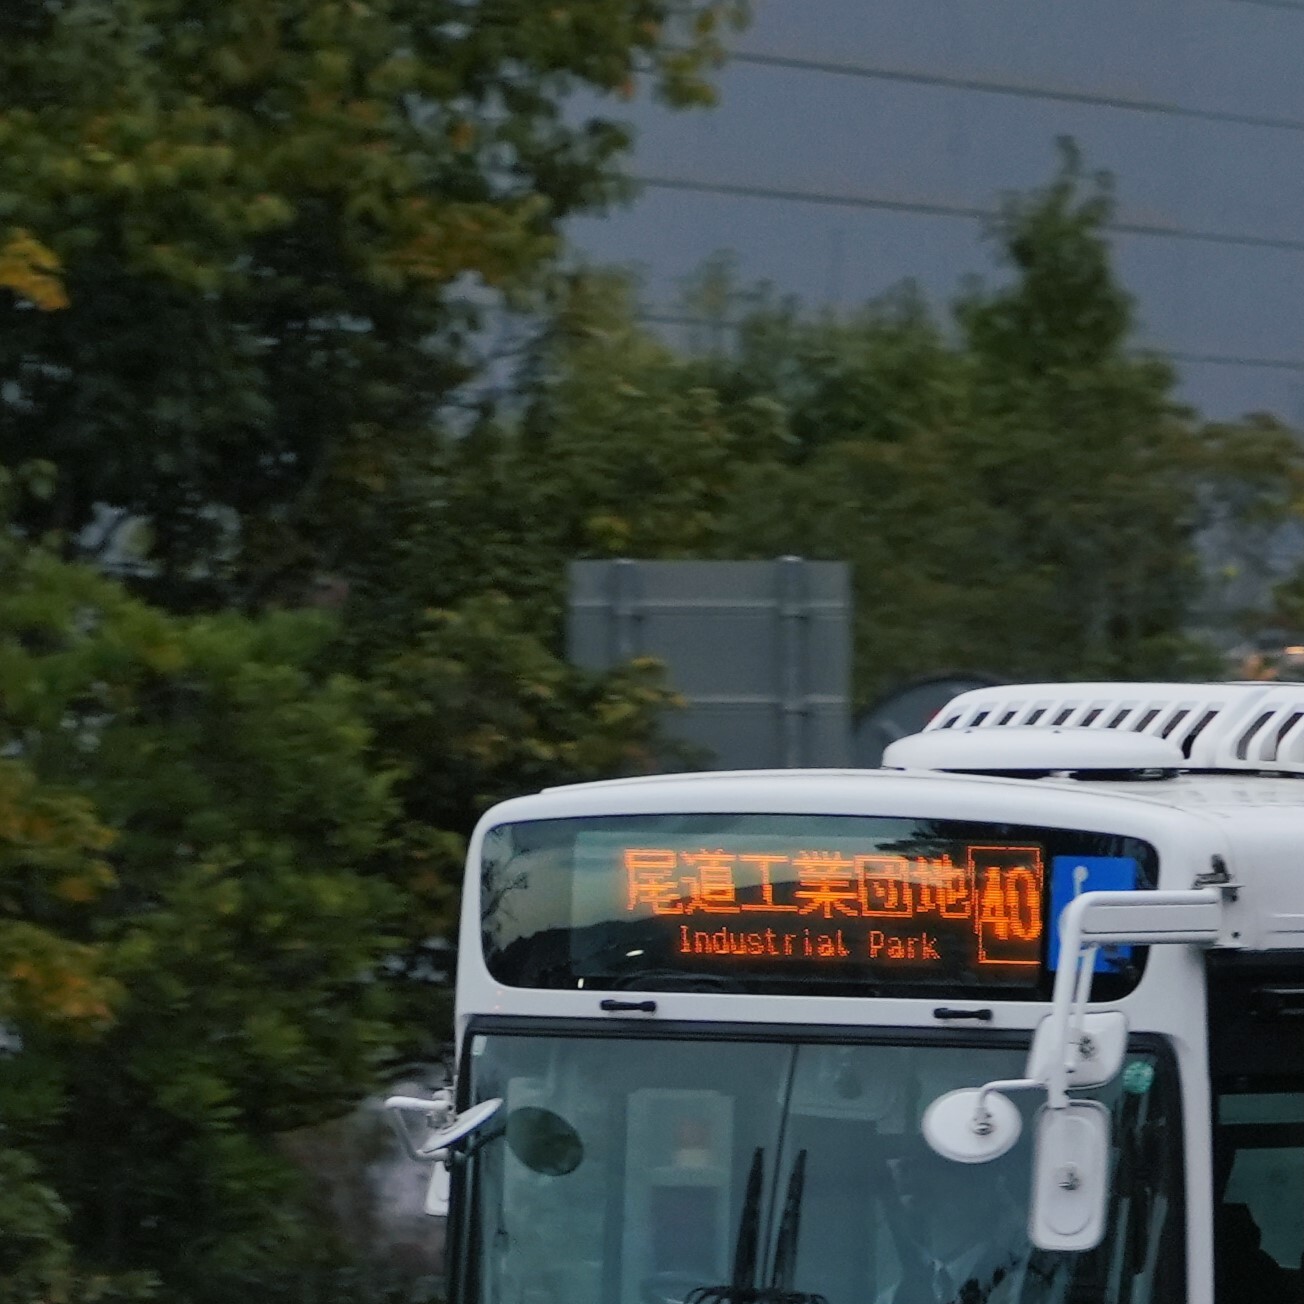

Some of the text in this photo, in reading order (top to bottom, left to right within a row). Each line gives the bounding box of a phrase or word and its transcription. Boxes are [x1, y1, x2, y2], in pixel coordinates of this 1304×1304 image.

[622, 846, 1043, 943] 尾道工業団地 40
[679, 925, 943, 962] Industrial Park
